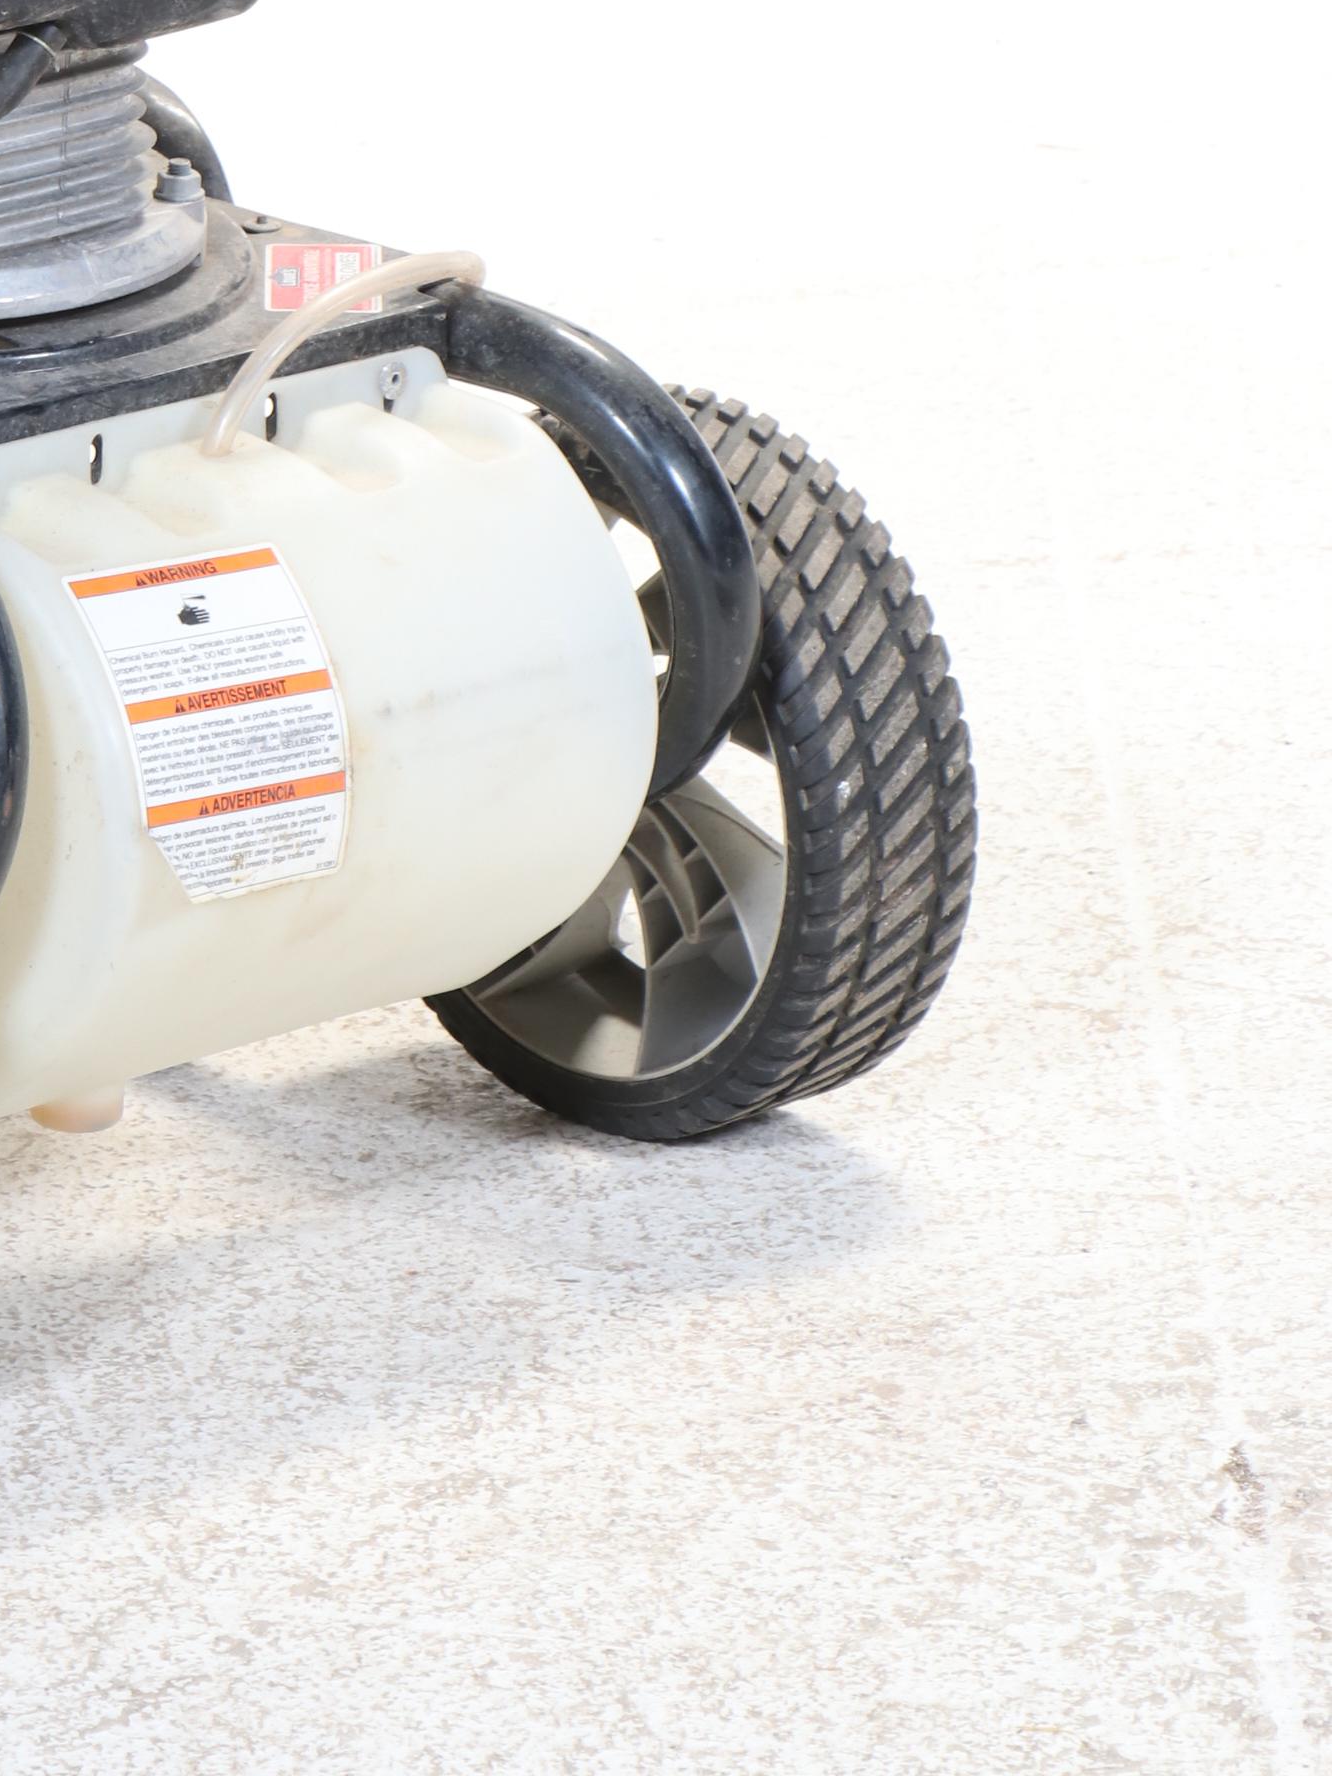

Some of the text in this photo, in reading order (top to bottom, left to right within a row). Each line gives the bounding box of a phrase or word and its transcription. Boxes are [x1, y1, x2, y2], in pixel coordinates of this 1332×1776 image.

[144, 560, 217, 584] WARNING
[186, 678, 288, 711] AVERTISSEMENT
[210, 783, 296, 813] ADVERTENCIA
